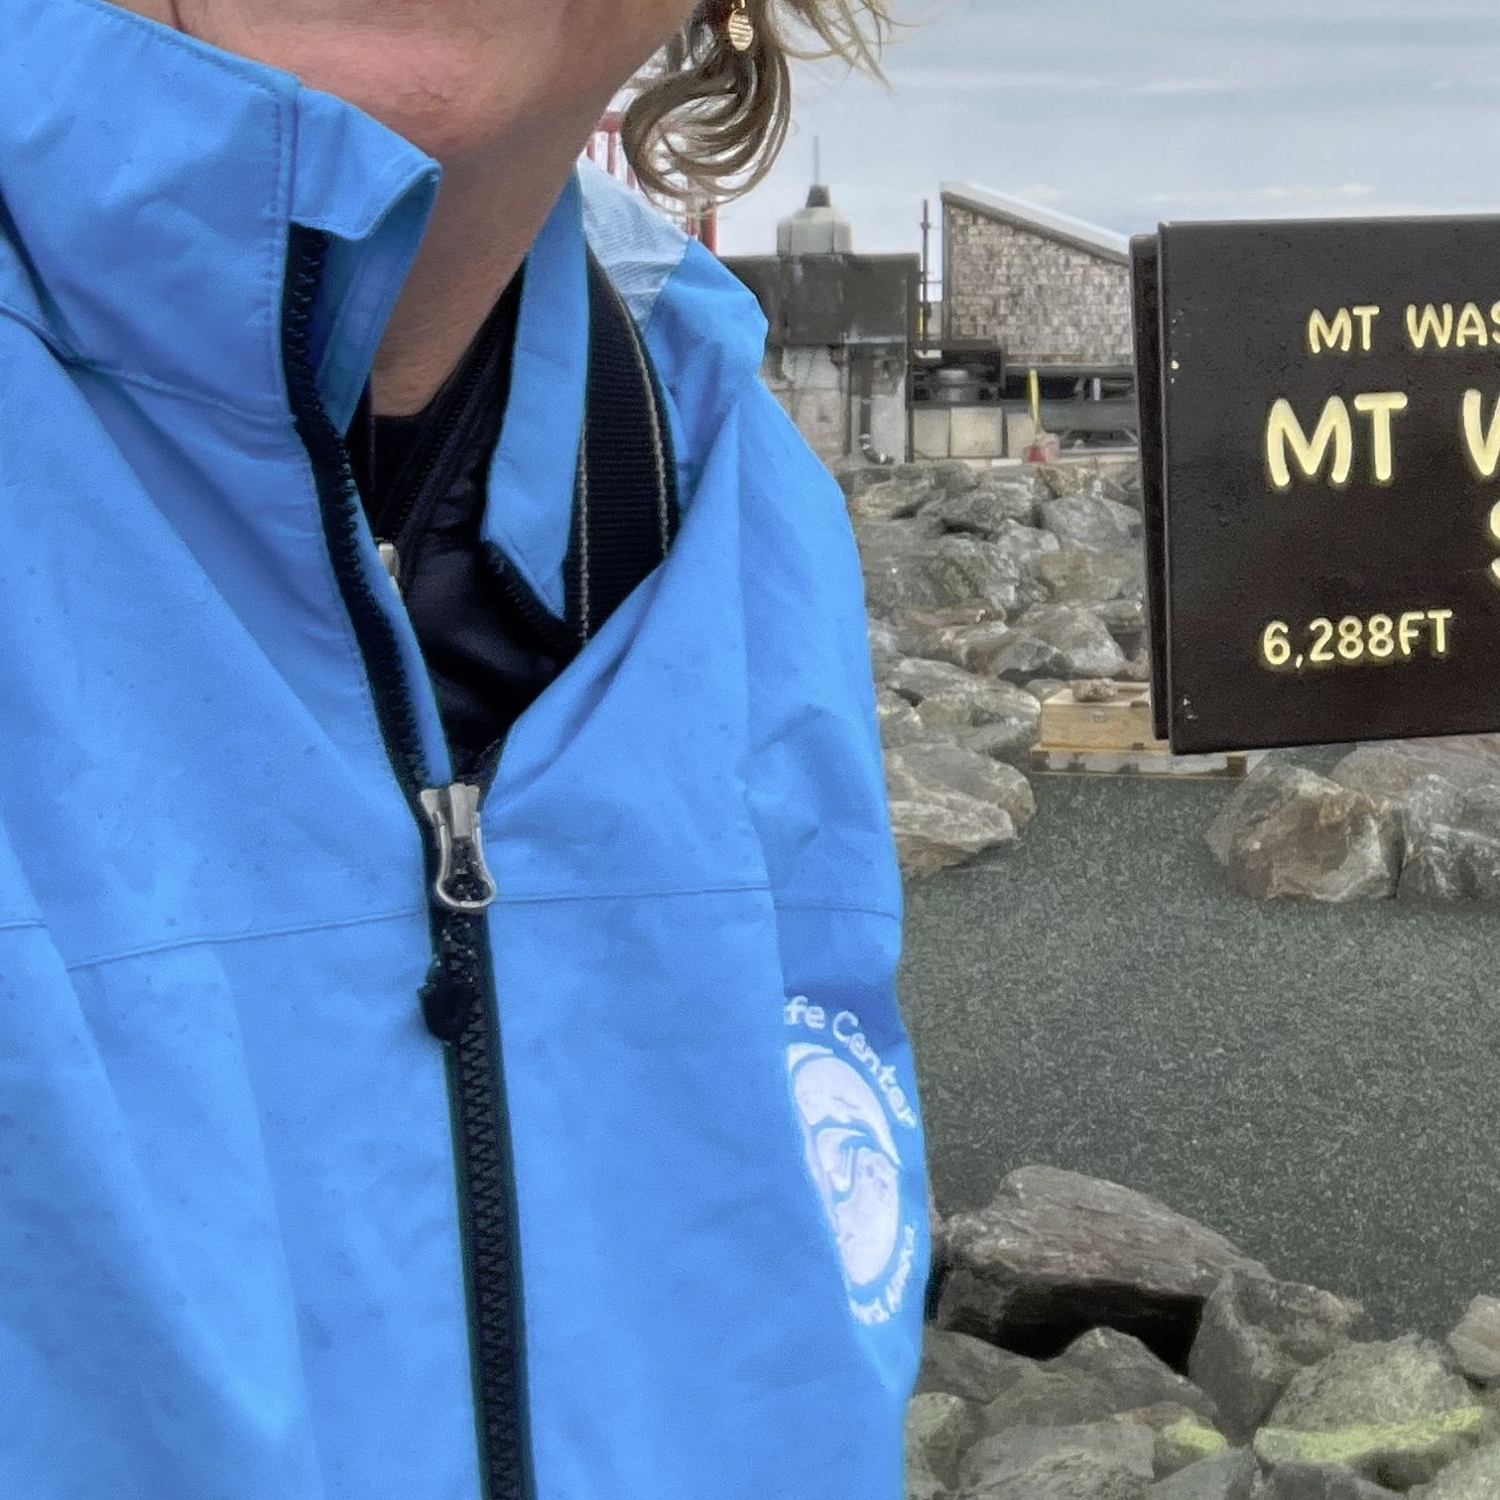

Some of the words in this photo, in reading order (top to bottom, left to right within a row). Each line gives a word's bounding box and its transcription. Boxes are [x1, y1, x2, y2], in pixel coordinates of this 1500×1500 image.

[1308, 305, 1380, 354] MT
[1266, 391, 1409, 488] MT
[1262, 609, 1454, 669] 6,288FT
[832, 1010, 917, 1129] Center
